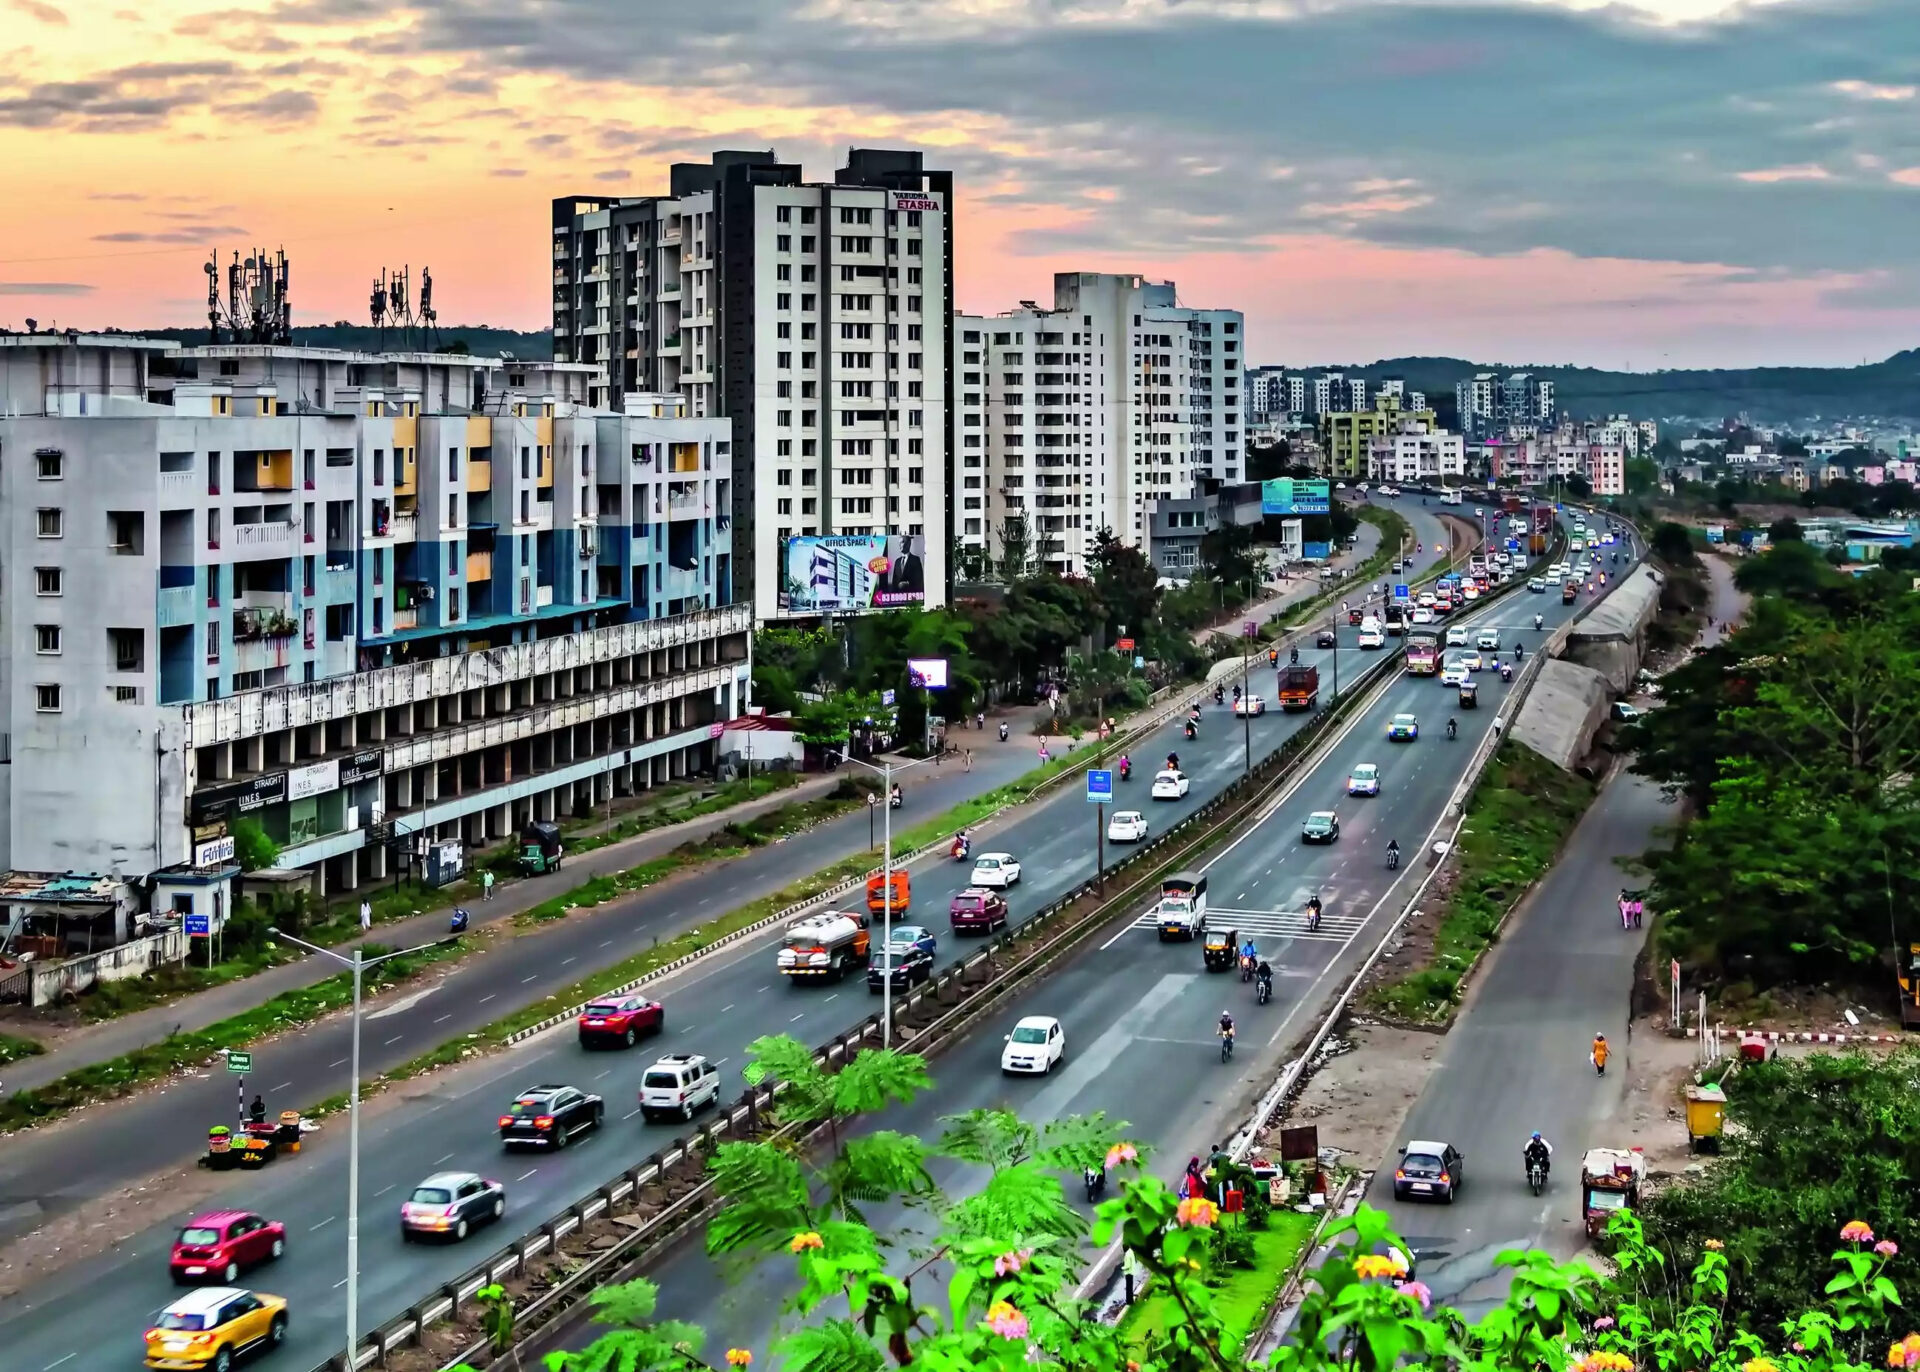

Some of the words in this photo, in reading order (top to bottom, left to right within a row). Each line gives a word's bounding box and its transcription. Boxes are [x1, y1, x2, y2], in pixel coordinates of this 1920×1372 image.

[898, 200, 939, 210] ETASHA
[847, 539, 866, 547] SPACE
[354, 752, 379, 765] STRAIGHT
[306, 764, 330, 777] STRAIGH
[254, 775, 283, 790] STRAIGHT
[294, 780, 312, 790] INES
